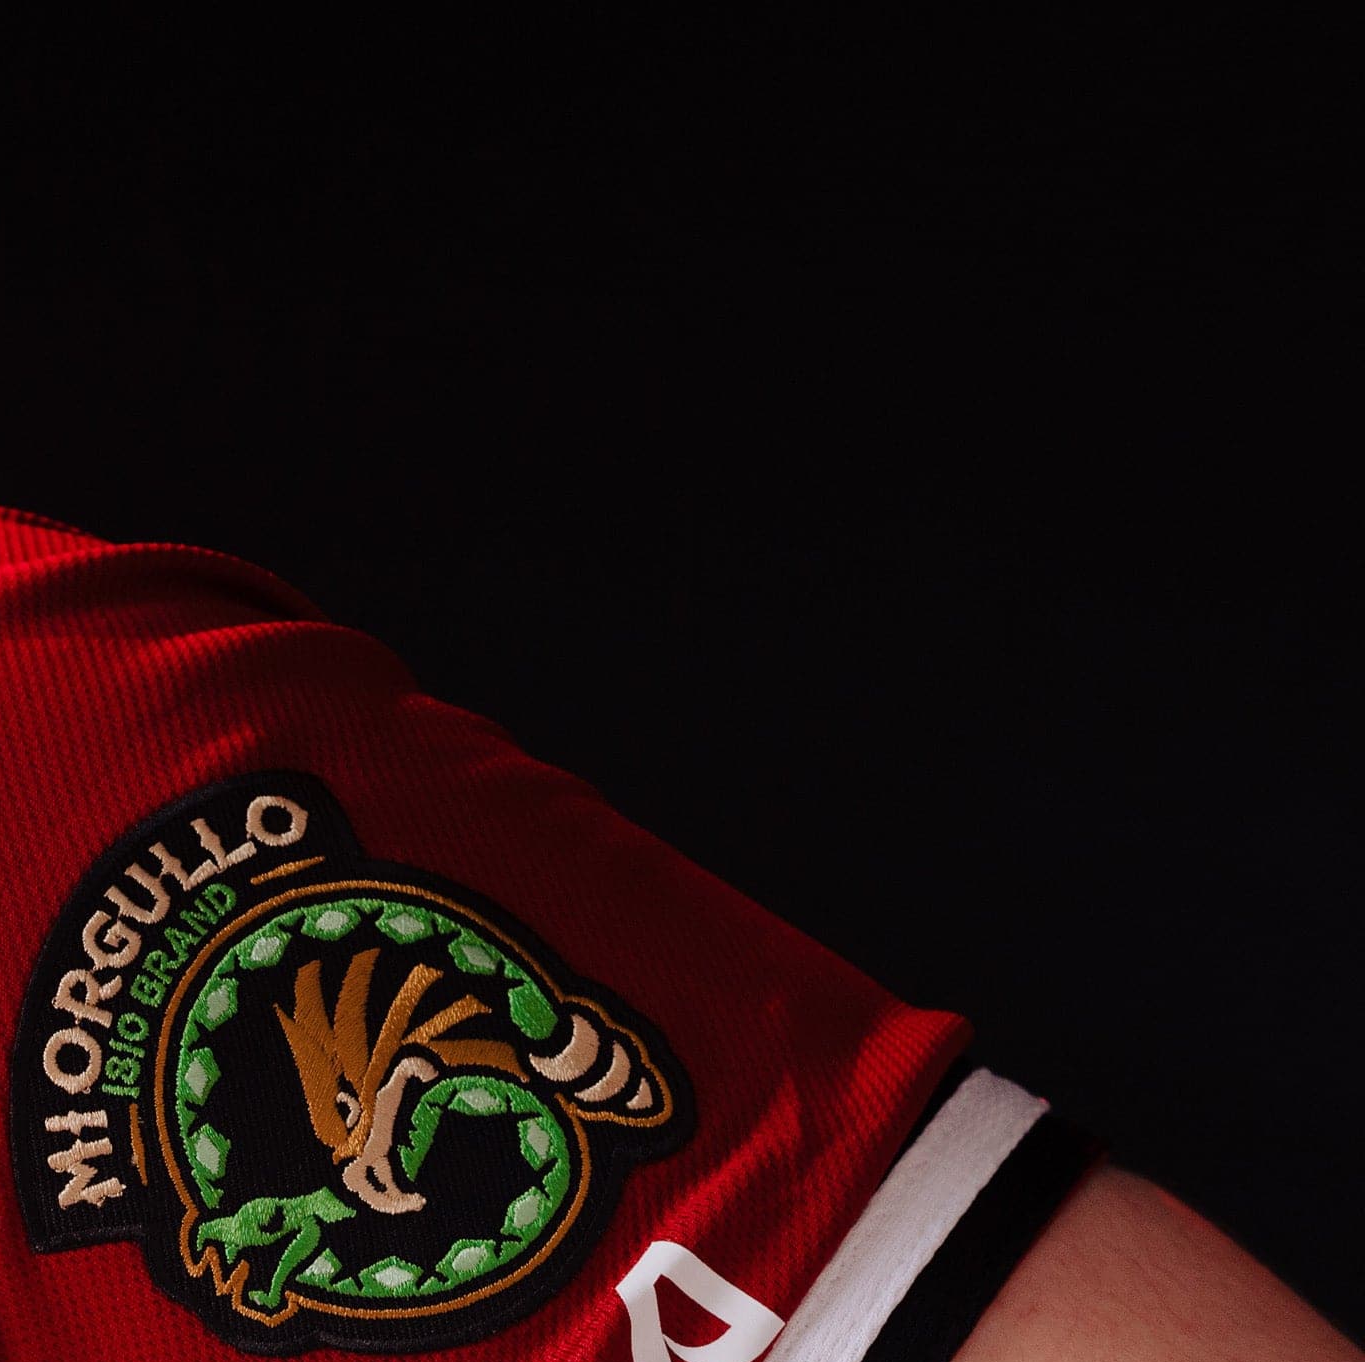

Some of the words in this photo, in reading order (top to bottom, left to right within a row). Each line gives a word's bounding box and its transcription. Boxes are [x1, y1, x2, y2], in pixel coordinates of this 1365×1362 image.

[43, 796, 307, 1094] ORGULLO
[102, 1013, 150, 1098] 1810
[130, 883, 237, 1008] BRAND
[44, 1109, 126, 1208] MI
